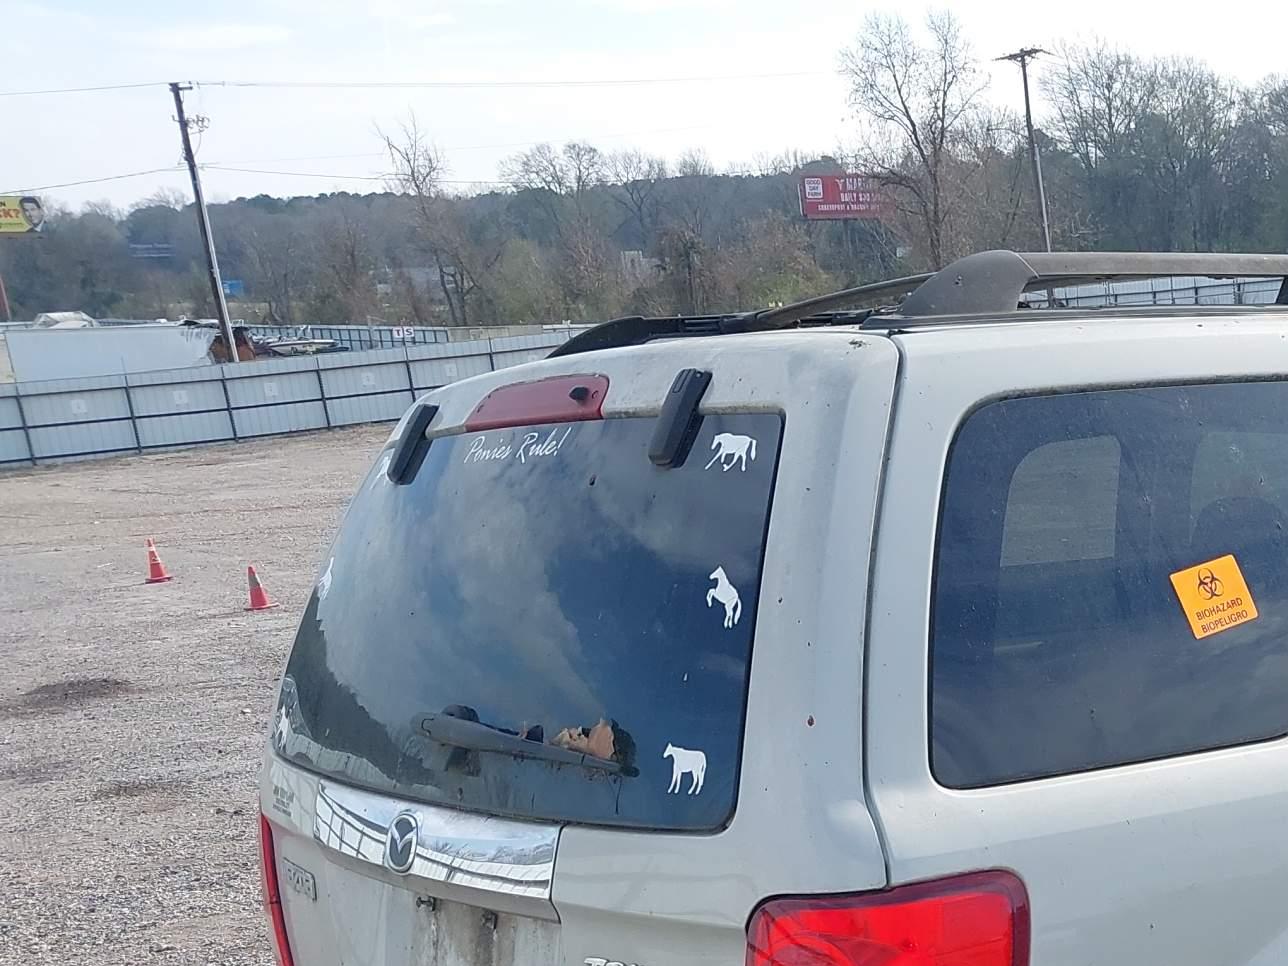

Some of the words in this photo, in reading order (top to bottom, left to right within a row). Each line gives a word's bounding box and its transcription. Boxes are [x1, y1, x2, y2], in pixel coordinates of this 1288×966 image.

[464, 435, 513, 464] Ponies
[516, 427, 572, 464] Rule!
[1196, 598, 1243, 621] BIOHAZARD
[1201, 609, 1248, 633] BIOPELIGRO
